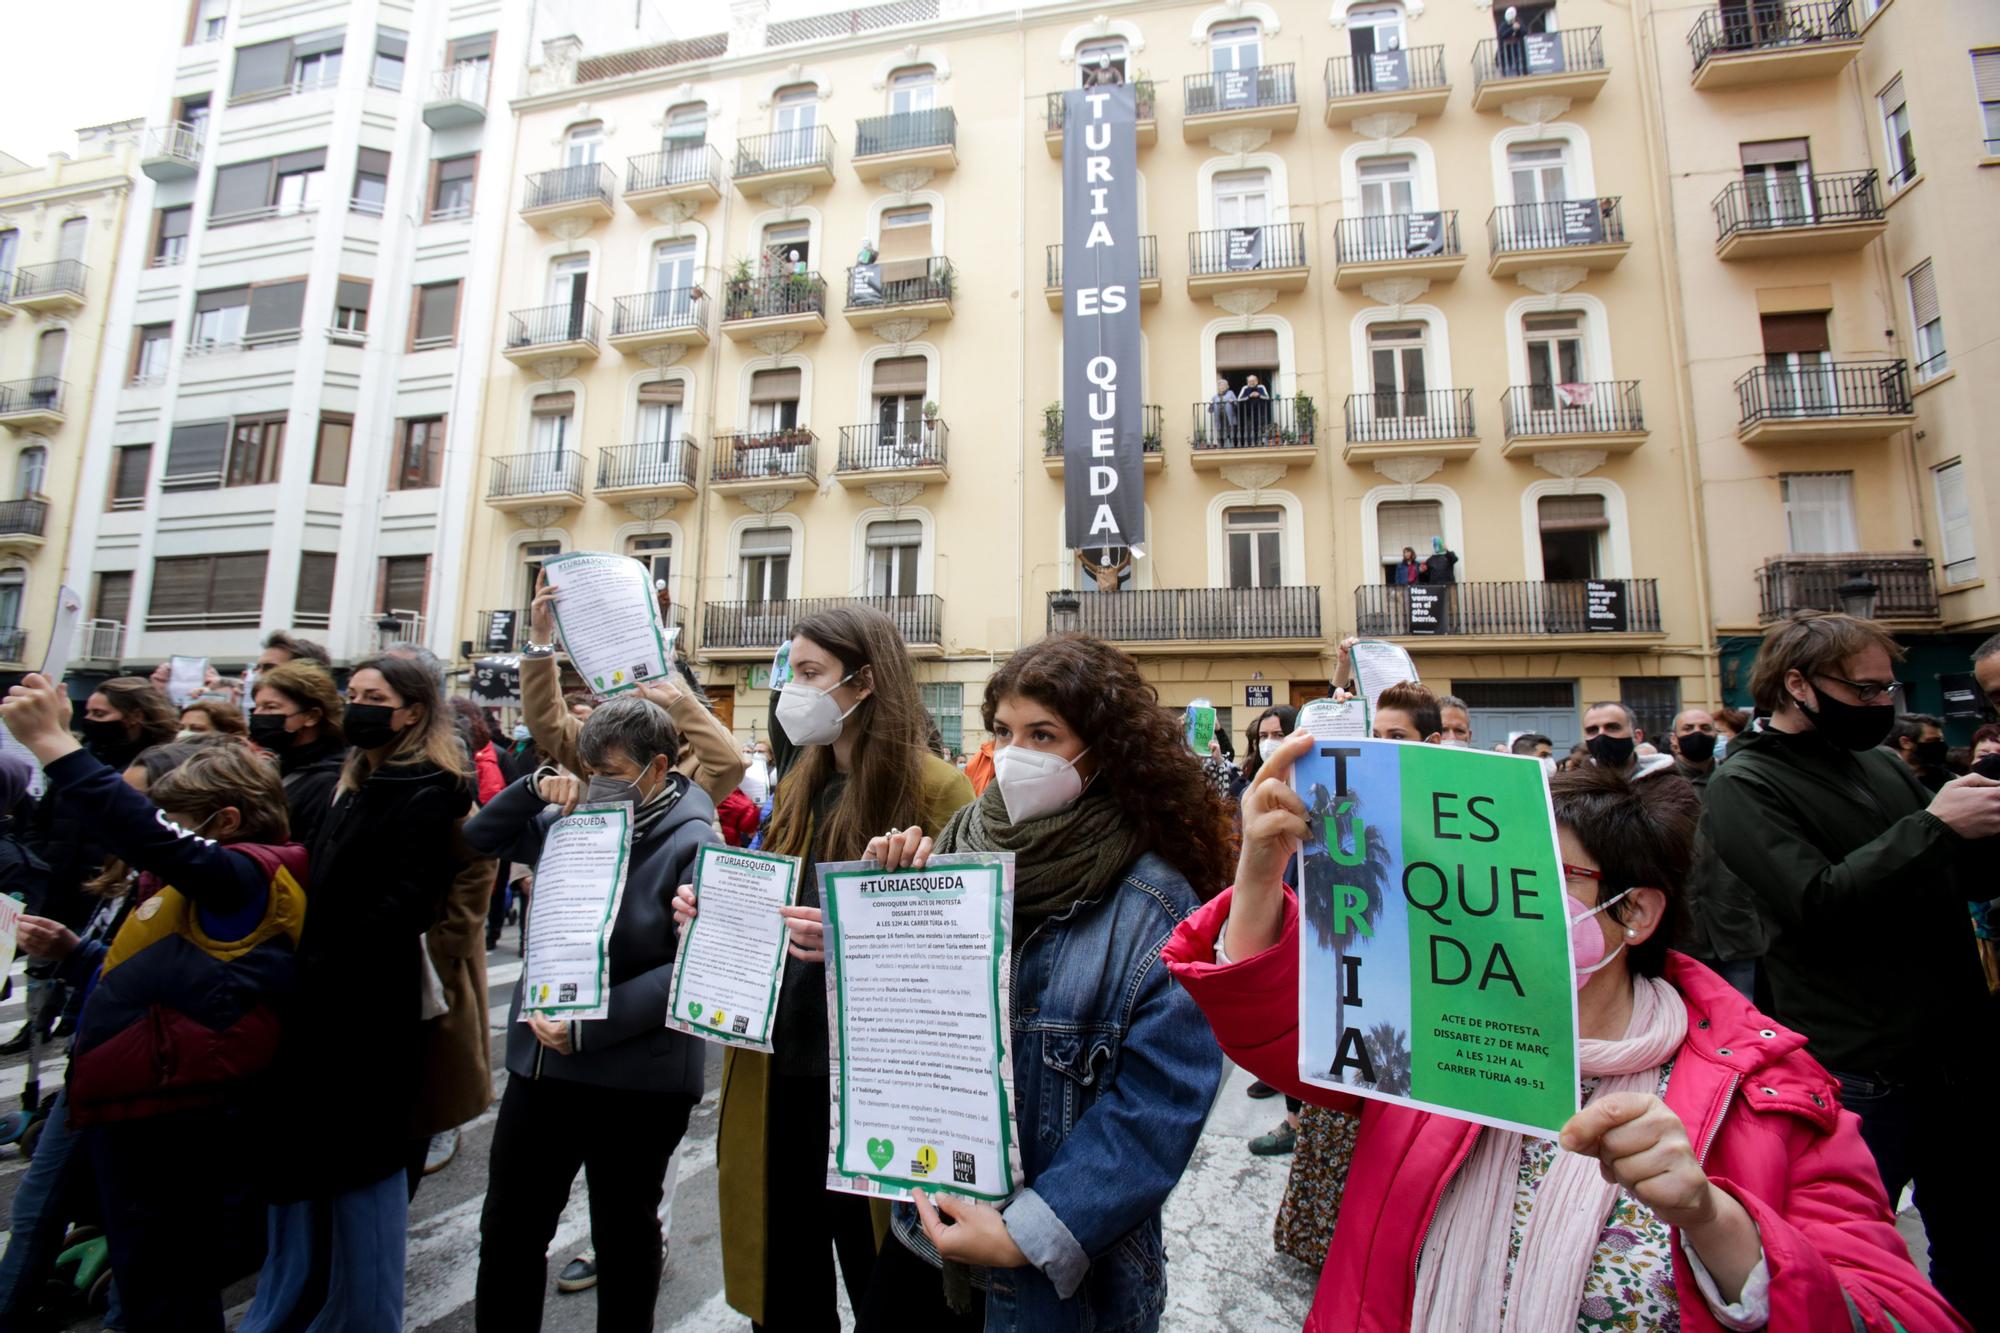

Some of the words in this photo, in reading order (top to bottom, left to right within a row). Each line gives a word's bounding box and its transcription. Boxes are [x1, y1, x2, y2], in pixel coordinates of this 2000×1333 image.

[1085, 93, 1114, 248] TURIA
[1076, 285, 1127, 316] ES
[1087, 356, 1120, 535] QUEDA
[1248, 697, 1269, 706] TURIA
[1432, 791, 1500, 843] ES
[860, 876, 964, 893] #TÚRIAESQUEDA
[1402, 861, 1544, 926] QUE
[1320, 748, 1377, 1084] TÚRIA
[1429, 934, 1526, 997] DA
[1441, 1014, 1466, 1025] ACTE
[1469, 1018, 1482, 1028] DE
[1486, 1020, 1540, 1037] PROTESTA
[1434, 1028, 1481, 1044] DISSABTE
[1484, 1036, 1496, 1046] 27
[1500, 1039, 1513, 1050] DE
[1516, 1042, 1550, 1057] MARÇ
[1456, 1049, 1463, 1058] A
[1466, 1050, 1483, 1061] LES
[1486, 1054, 1506, 1065] 12H
[1510, 1058, 1524, 1068] AL
[1437, 1062, 1476, 1077] CARRER
[1514, 1076, 1544, 1090] 49-51
